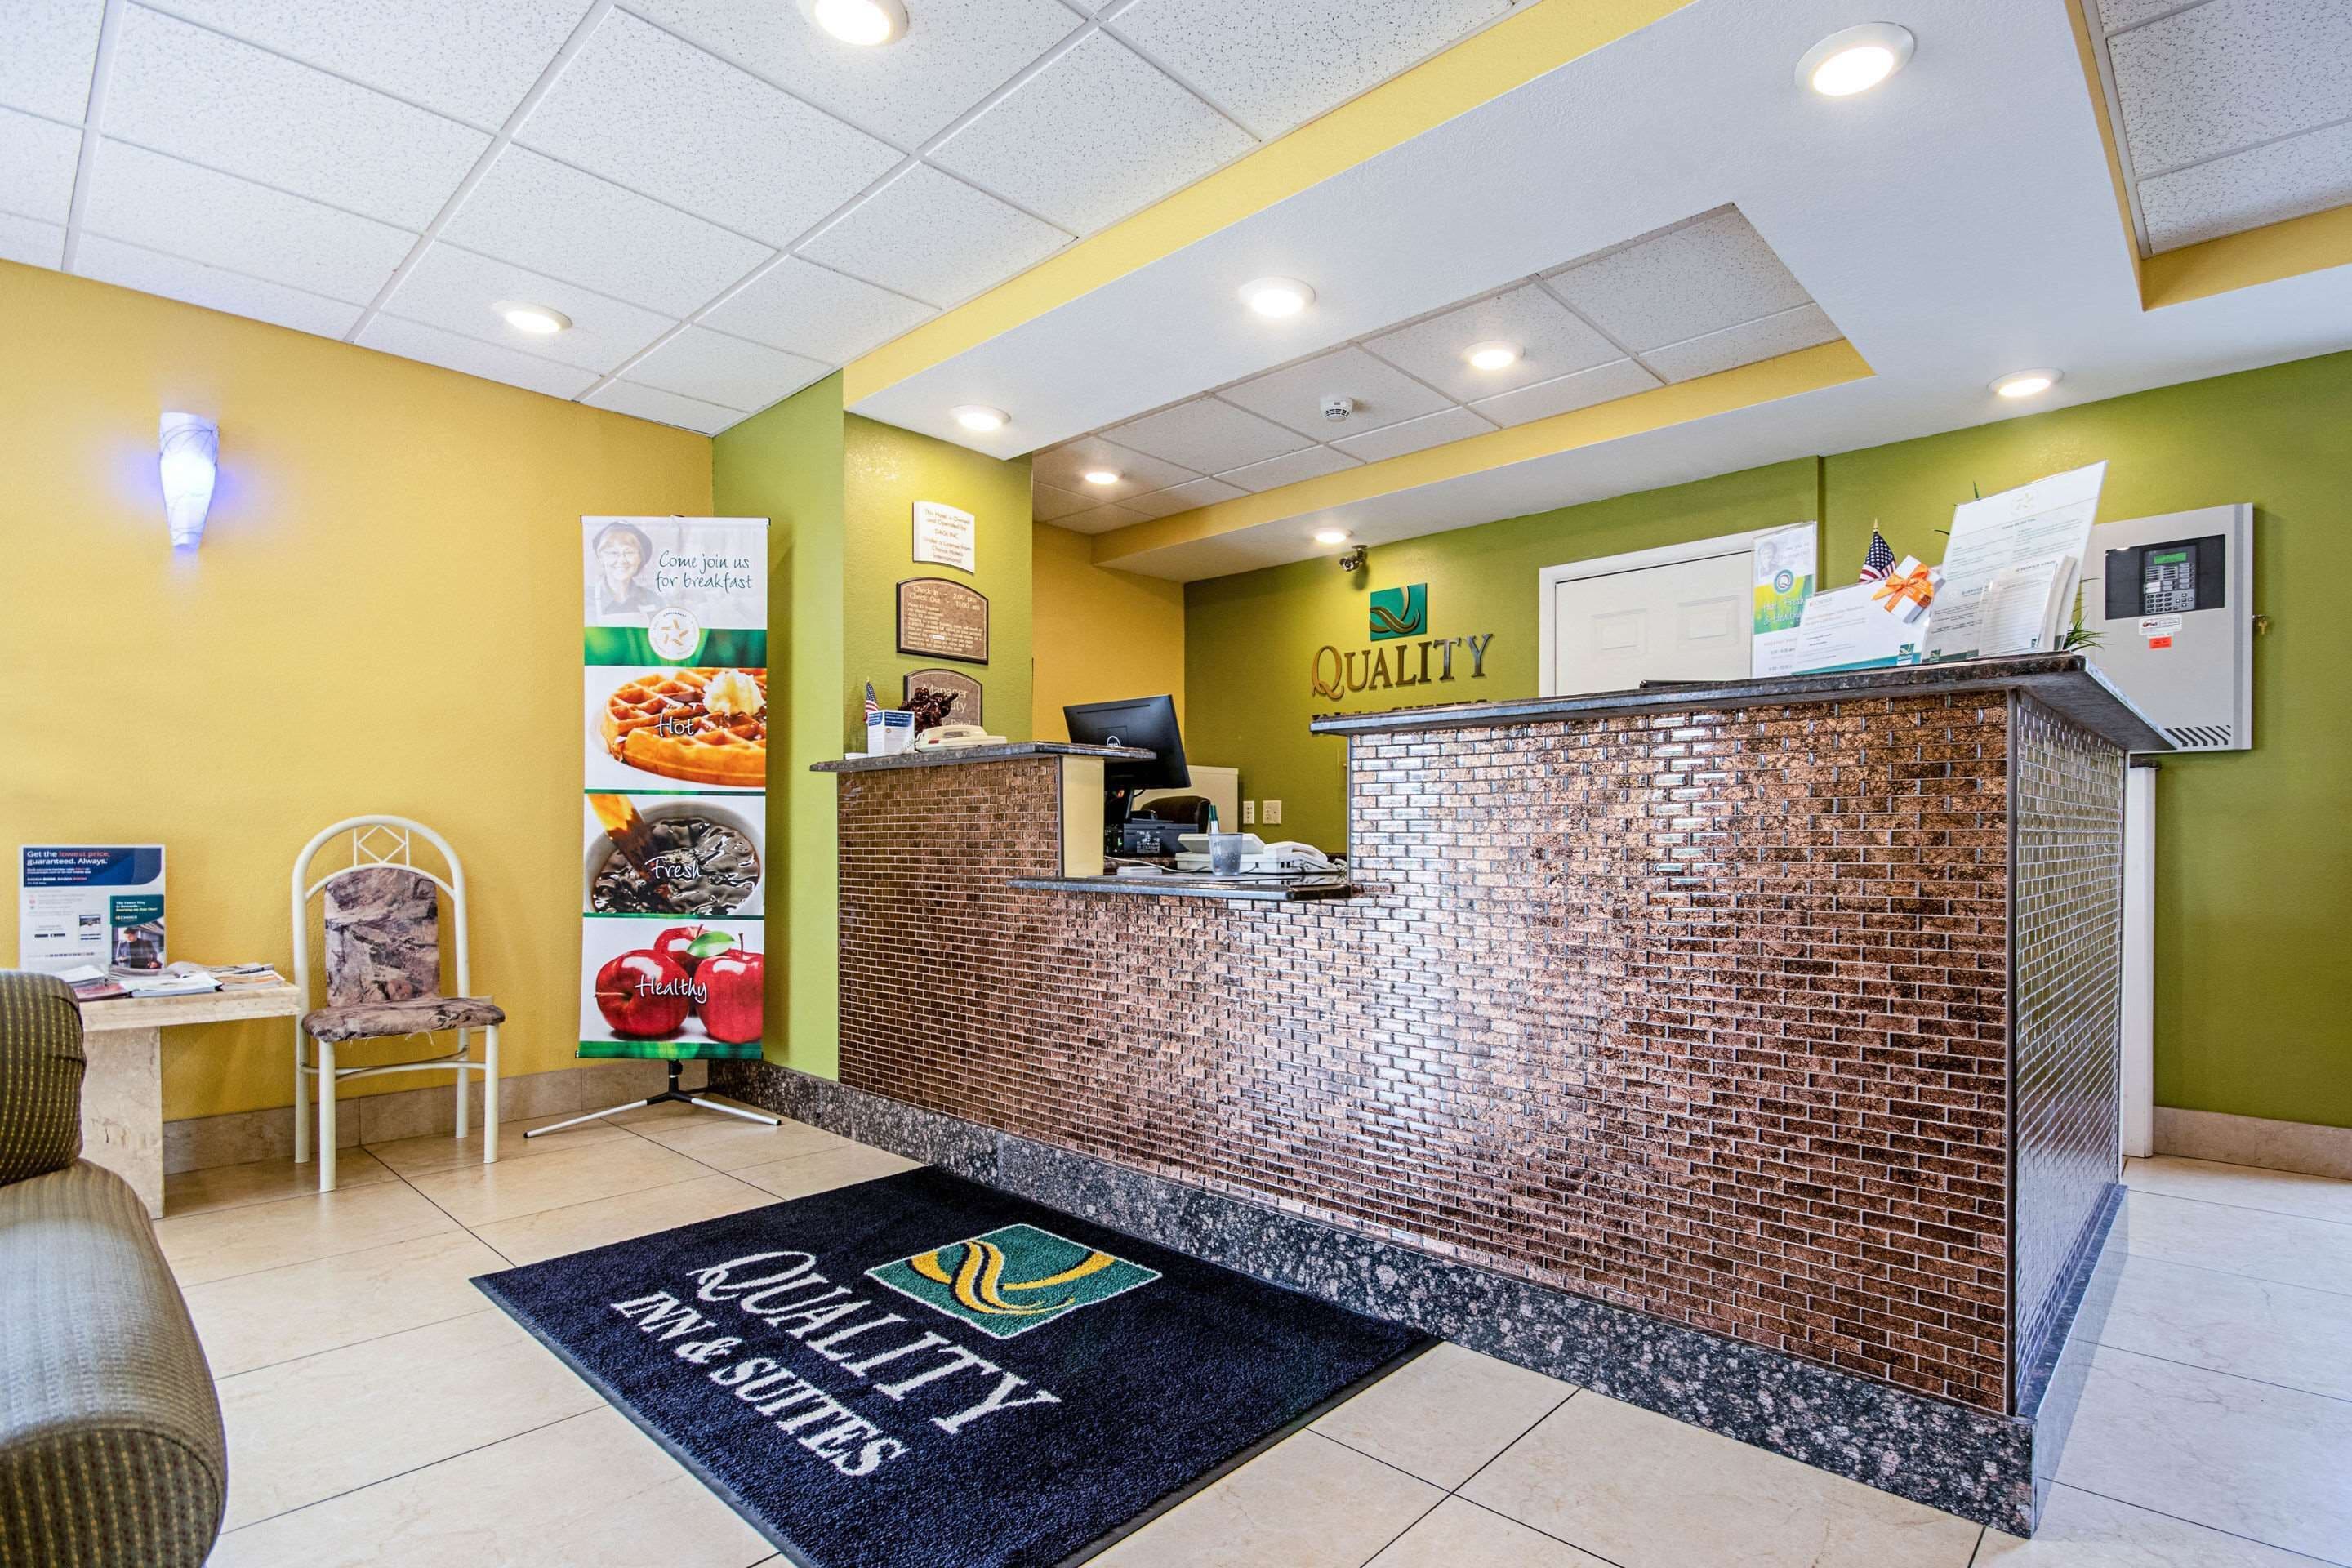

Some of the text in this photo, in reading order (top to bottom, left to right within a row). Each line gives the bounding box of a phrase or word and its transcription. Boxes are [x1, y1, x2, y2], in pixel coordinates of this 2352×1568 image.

[659, 550, 750, 575] Come join us
[655, 570, 752, 594] for breakfast
[913, 586, 930, 595] Check
[909, 593, 928, 602] Check
[1311, 633, 1494, 702] QUALITY
[923, 683, 968, 700] Manager
[950, 700, 967, 713] uty
[654, 712, 695, 737] Hot
[27, 858, 76, 866] guaranteed.
[644, 856, 702, 880] Fresh
[635, 974, 708, 1004] Healthy
[686, 1250, 1062, 1434] QUALITY
[610, 1289, 914, 1477] INN & SUITES
